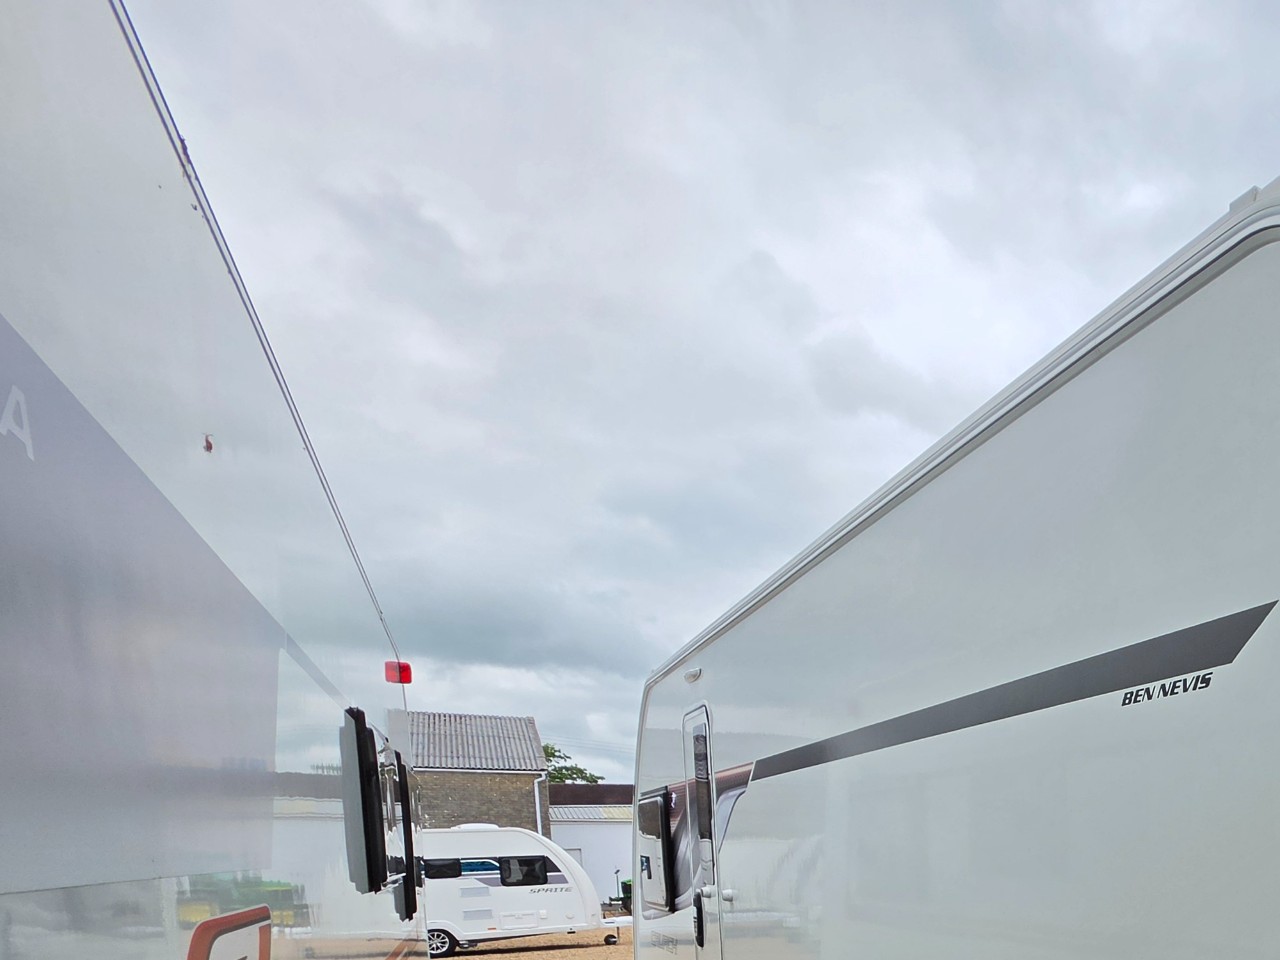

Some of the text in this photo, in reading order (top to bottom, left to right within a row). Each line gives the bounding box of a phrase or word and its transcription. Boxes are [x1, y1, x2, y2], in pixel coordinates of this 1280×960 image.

[1121, 672, 1213, 706] BEN NEVIS
[529, 886, 573, 894] SPRITE
